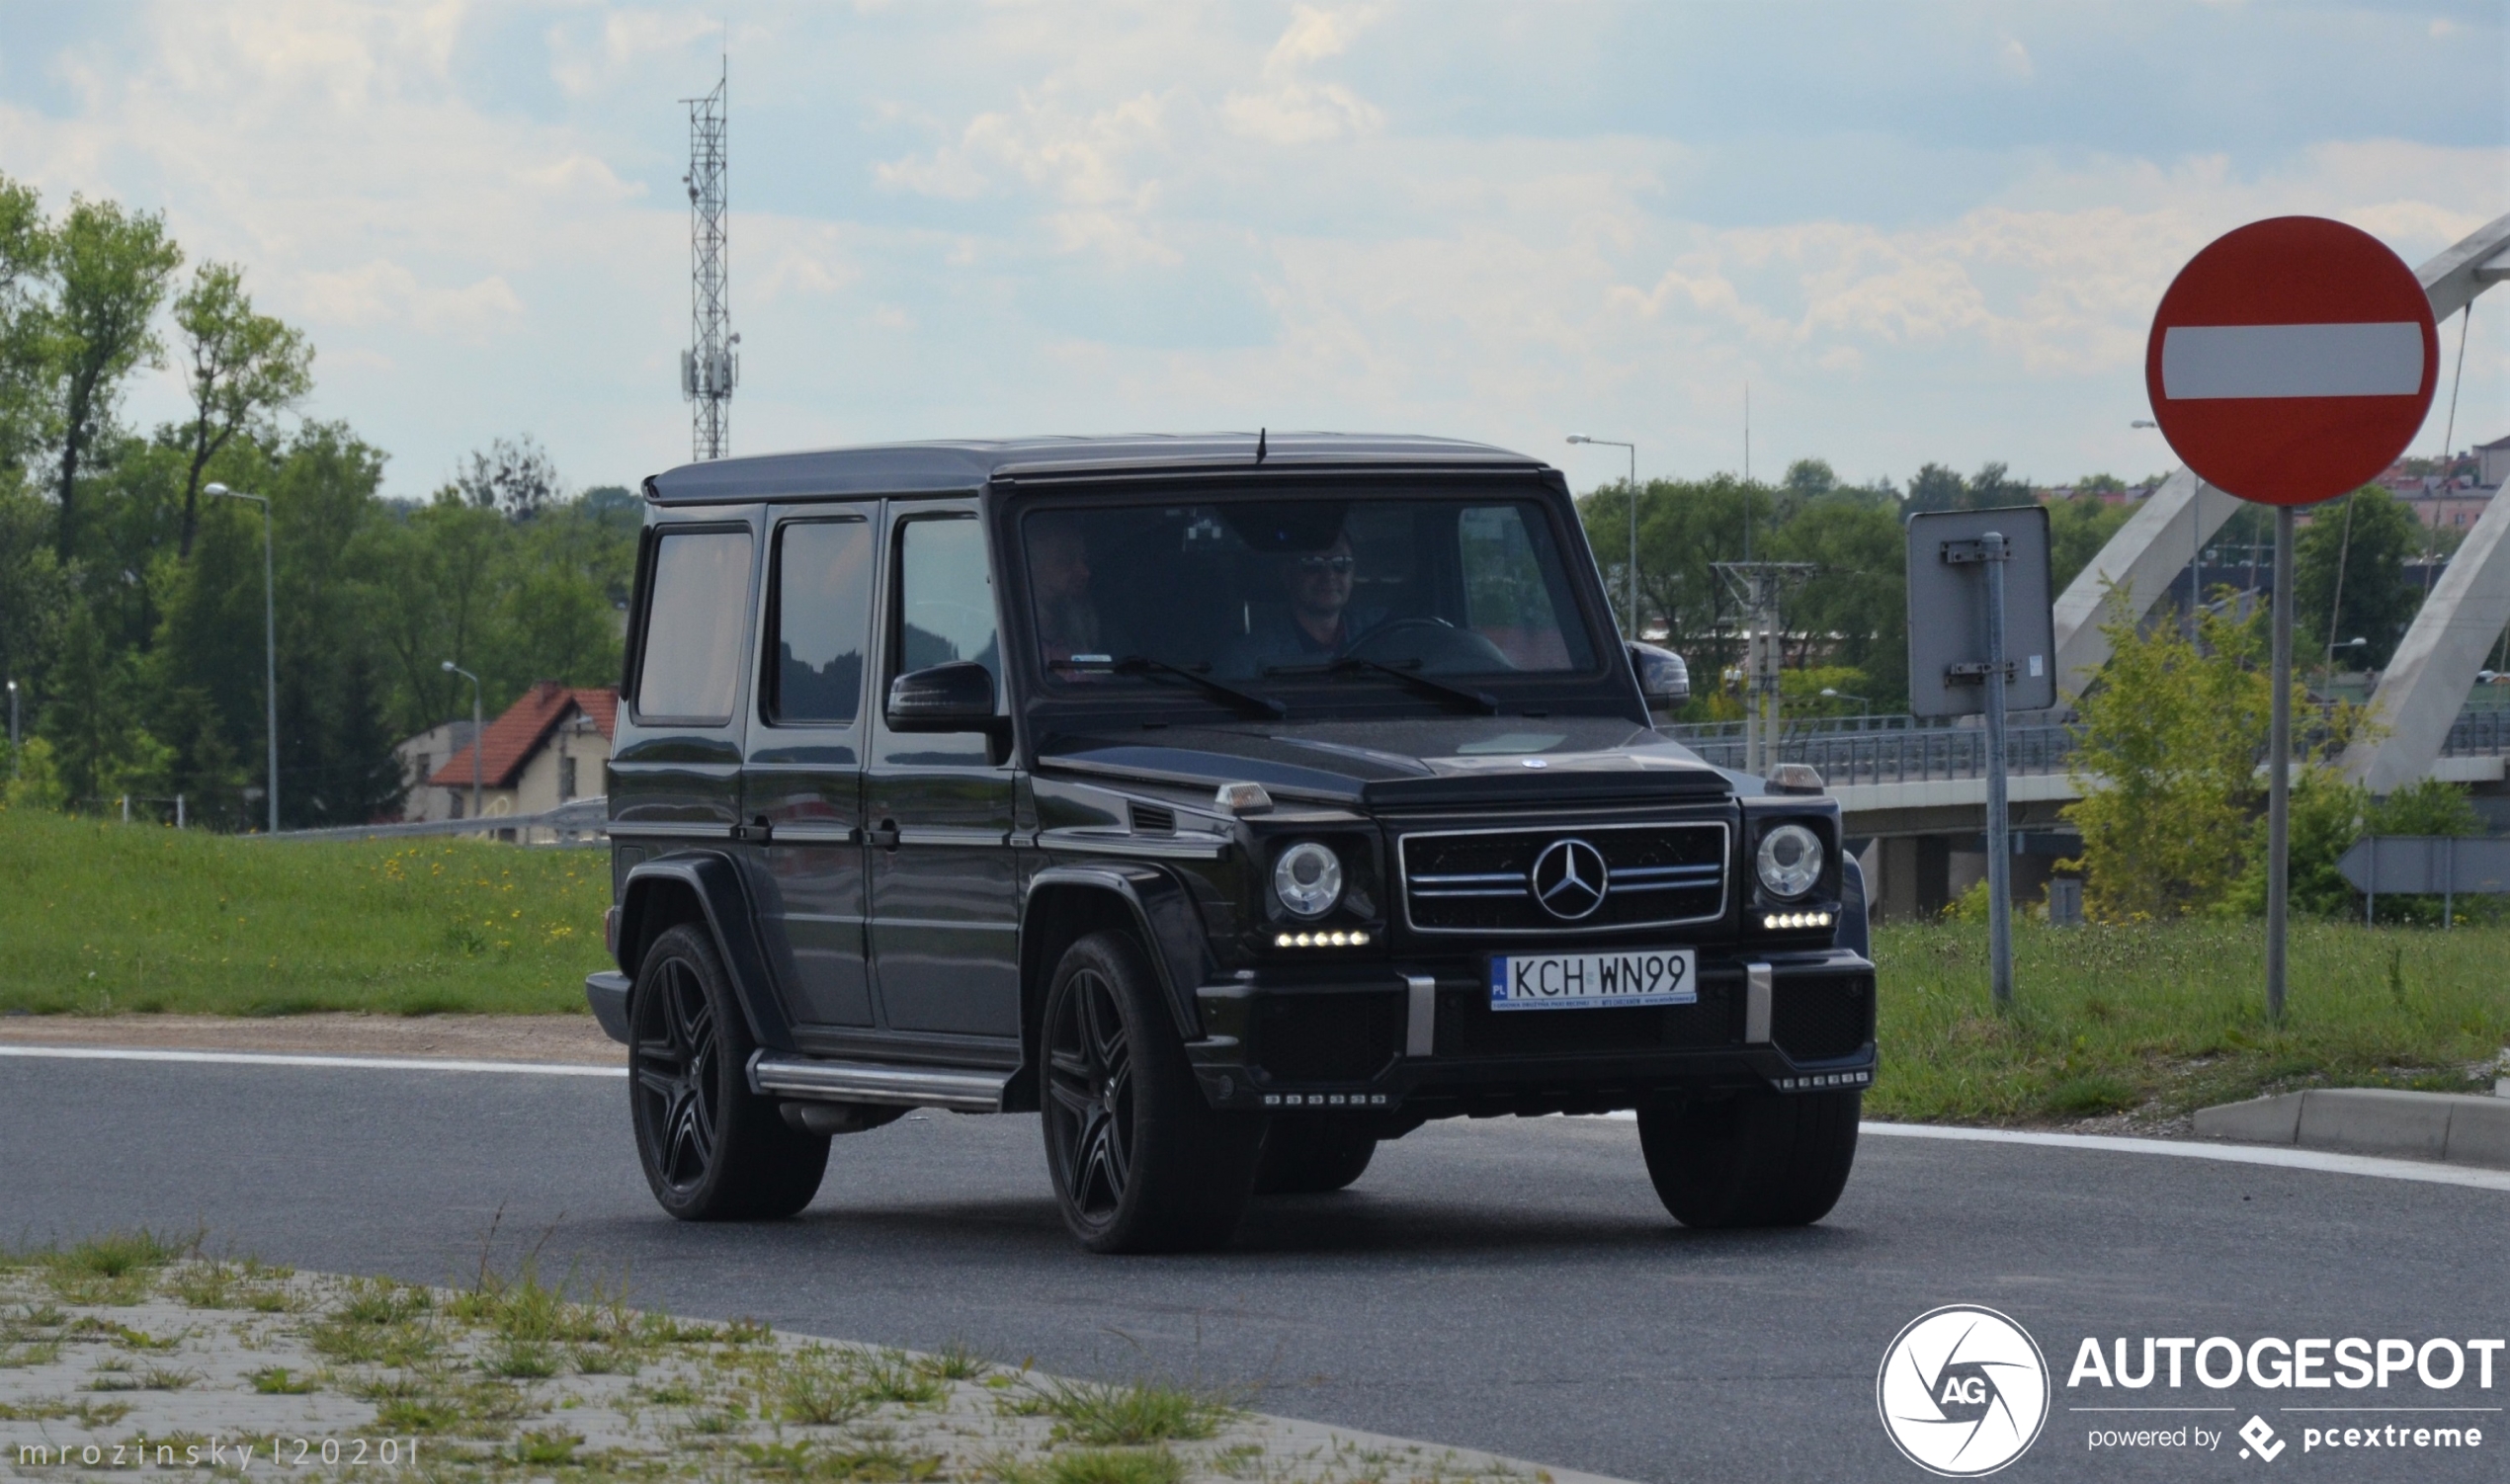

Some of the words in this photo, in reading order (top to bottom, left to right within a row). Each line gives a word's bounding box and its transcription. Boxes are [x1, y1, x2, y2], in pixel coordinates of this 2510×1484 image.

[1515, 958, 1584, 997] KCH
[1599, 954, 1686, 994] WN99
[1492, 985, 1506, 996] PL
